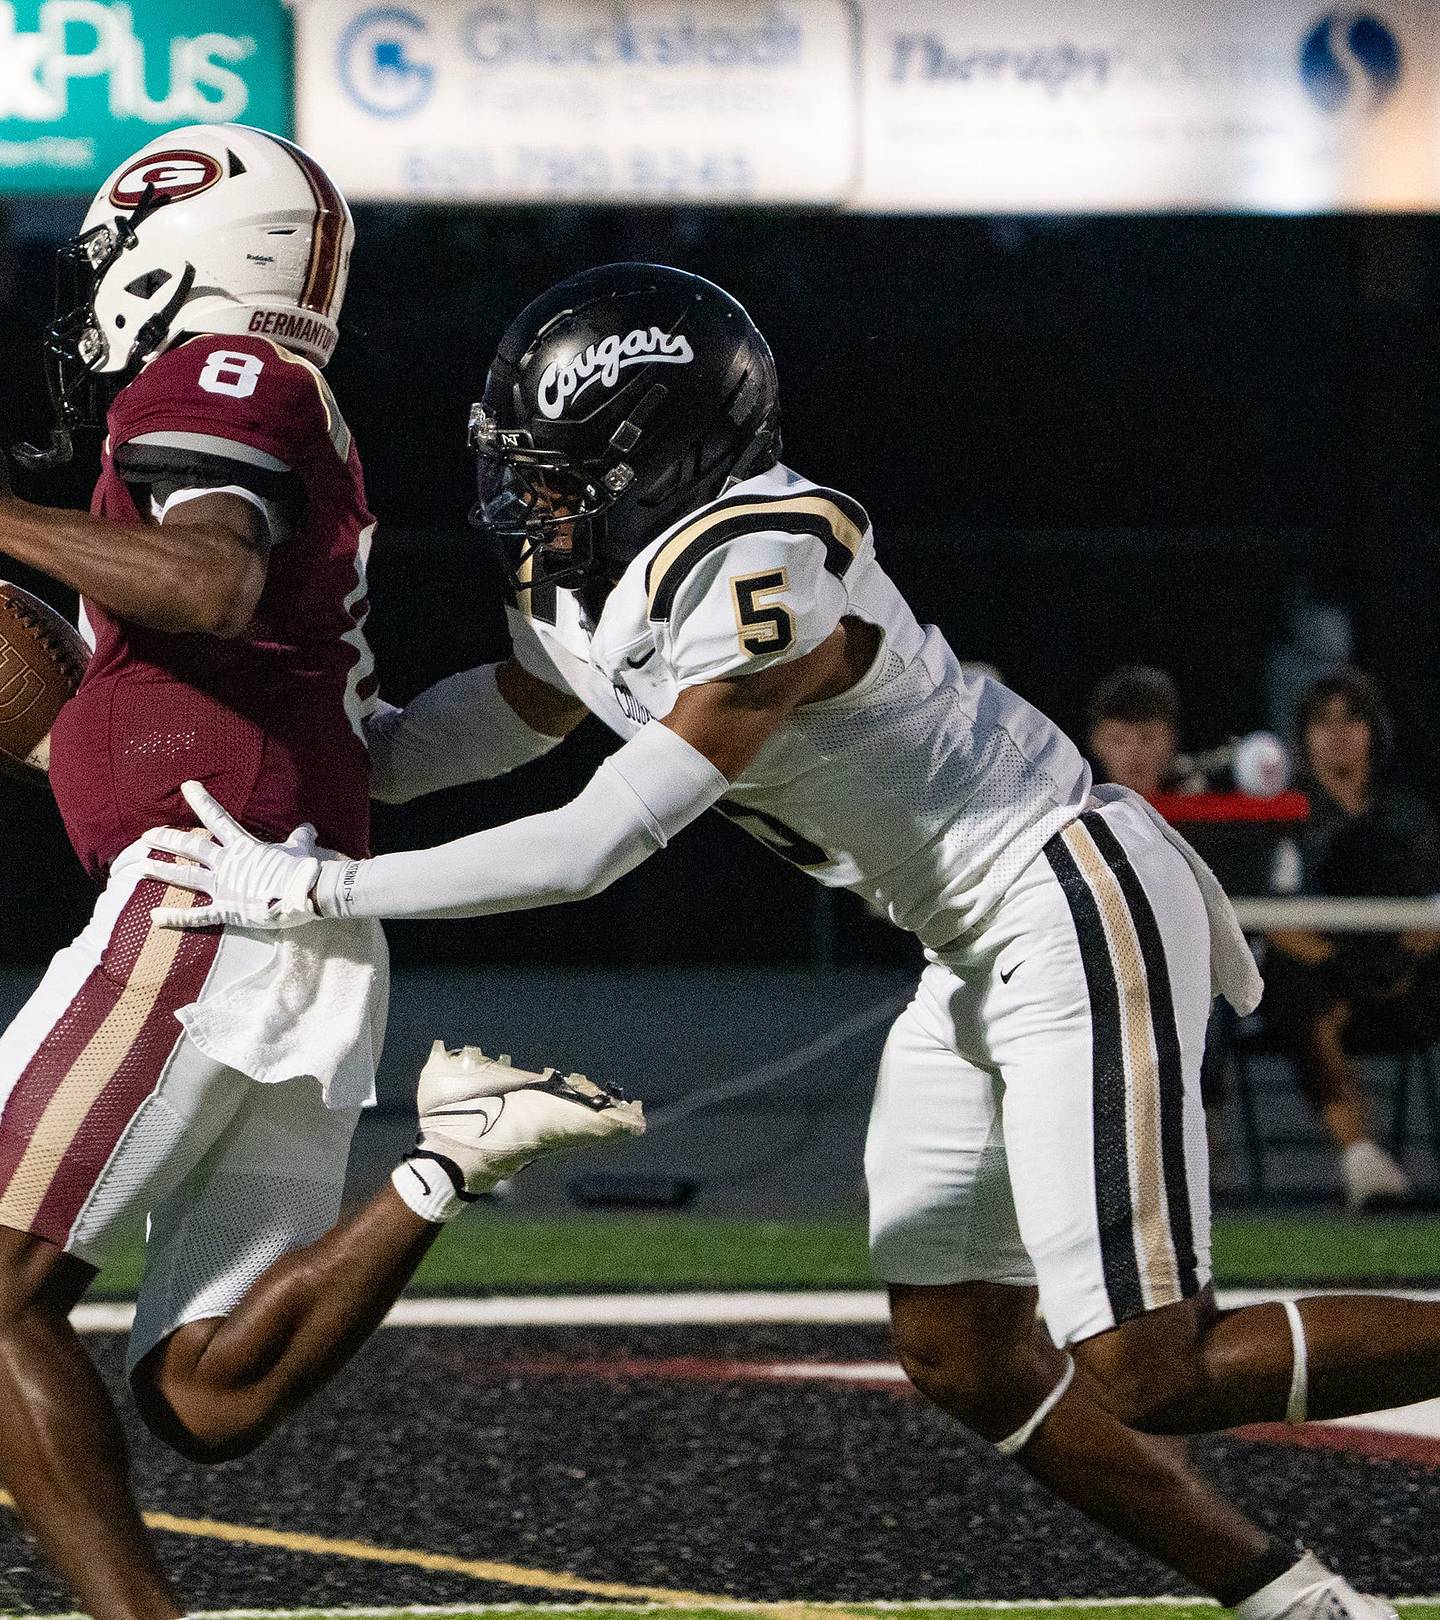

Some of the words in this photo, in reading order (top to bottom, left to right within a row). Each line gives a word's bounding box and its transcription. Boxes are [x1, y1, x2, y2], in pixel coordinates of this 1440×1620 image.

[197, 349, 264, 399] 8
[537, 326, 694, 419] Cougars
[729, 566, 797, 658] 5
